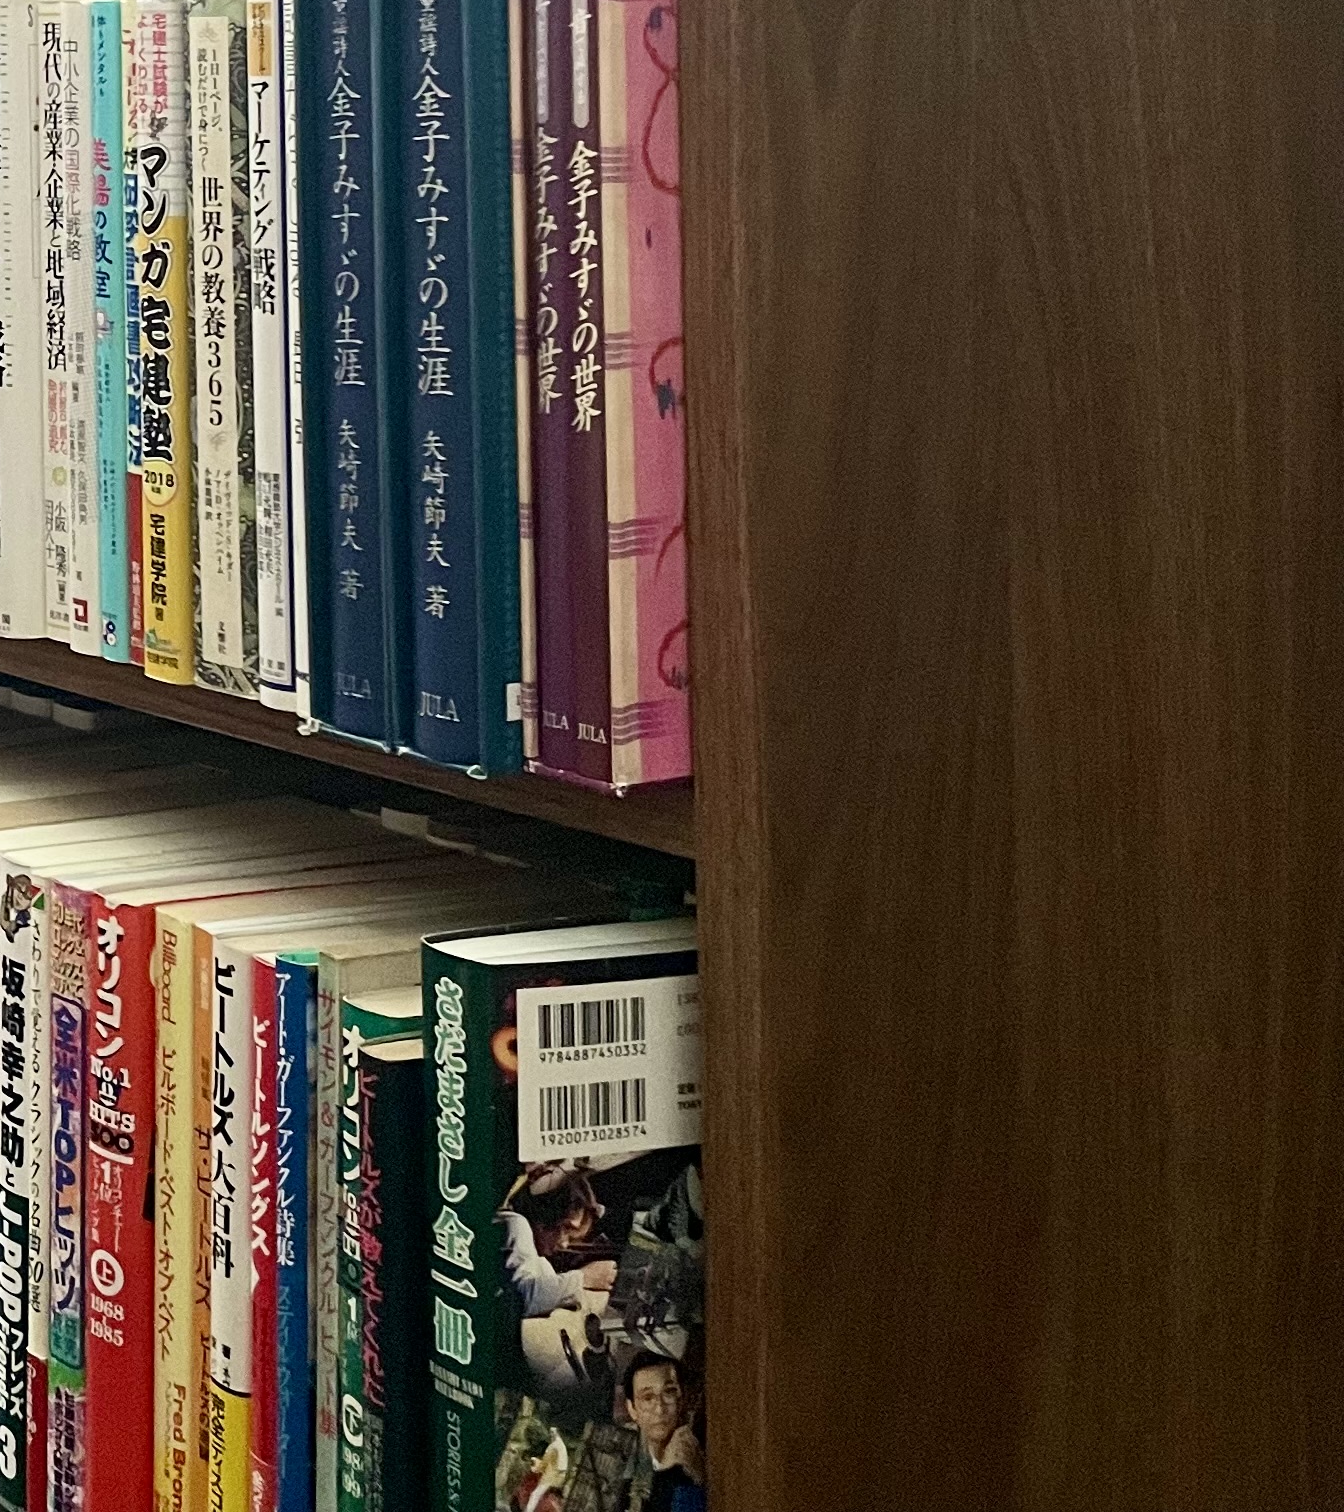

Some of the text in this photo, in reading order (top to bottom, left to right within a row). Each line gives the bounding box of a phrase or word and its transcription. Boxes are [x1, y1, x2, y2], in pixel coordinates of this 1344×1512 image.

[42, 21, 68, 372] 現代の産業・企業と地域経済
[62, 38, 81, 262] 中小企業の国際化戦略
[251, 80, 278, 316] マーケティング戦略
[200, 176, 227, 426] 世界の教養365
[326, 76, 366, 387] 金子みすゞの生涯
[411, 76, 455, 398] 金子みすゞの生涯
[569, 141, 602, 432] 金子みすゞの世界
[138, 145, 174, 462] マンガ宅建塾
[143, 468, 176, 490] 2018
[337, 418, 364, 552] 矢崎節夫
[420, 430, 450, 568] 矢崎節夫
[338, 568, 365, 601] 著
[422, 584, 451, 620] 著
[417, 690, 460, 723] JULA
[577, 720, 607, 745] JULA
[95, 915, 125, 1059] オリコン
[539, 1042, 647, 1064] 9784887450332
[1, 954, 26, 1190] 坂崎幸之助と
[89, 1098, 137, 1134] HITS
[276, 972, 295, 1267] アート・ガーファンクル詩集
[540, 1126, 648, 1147] 1920073028574
[162, 929, 187, 1443] Billboard Fred
[89, 1320, 124, 1347] 1985
[90, 1294, 125, 1322] 1968
